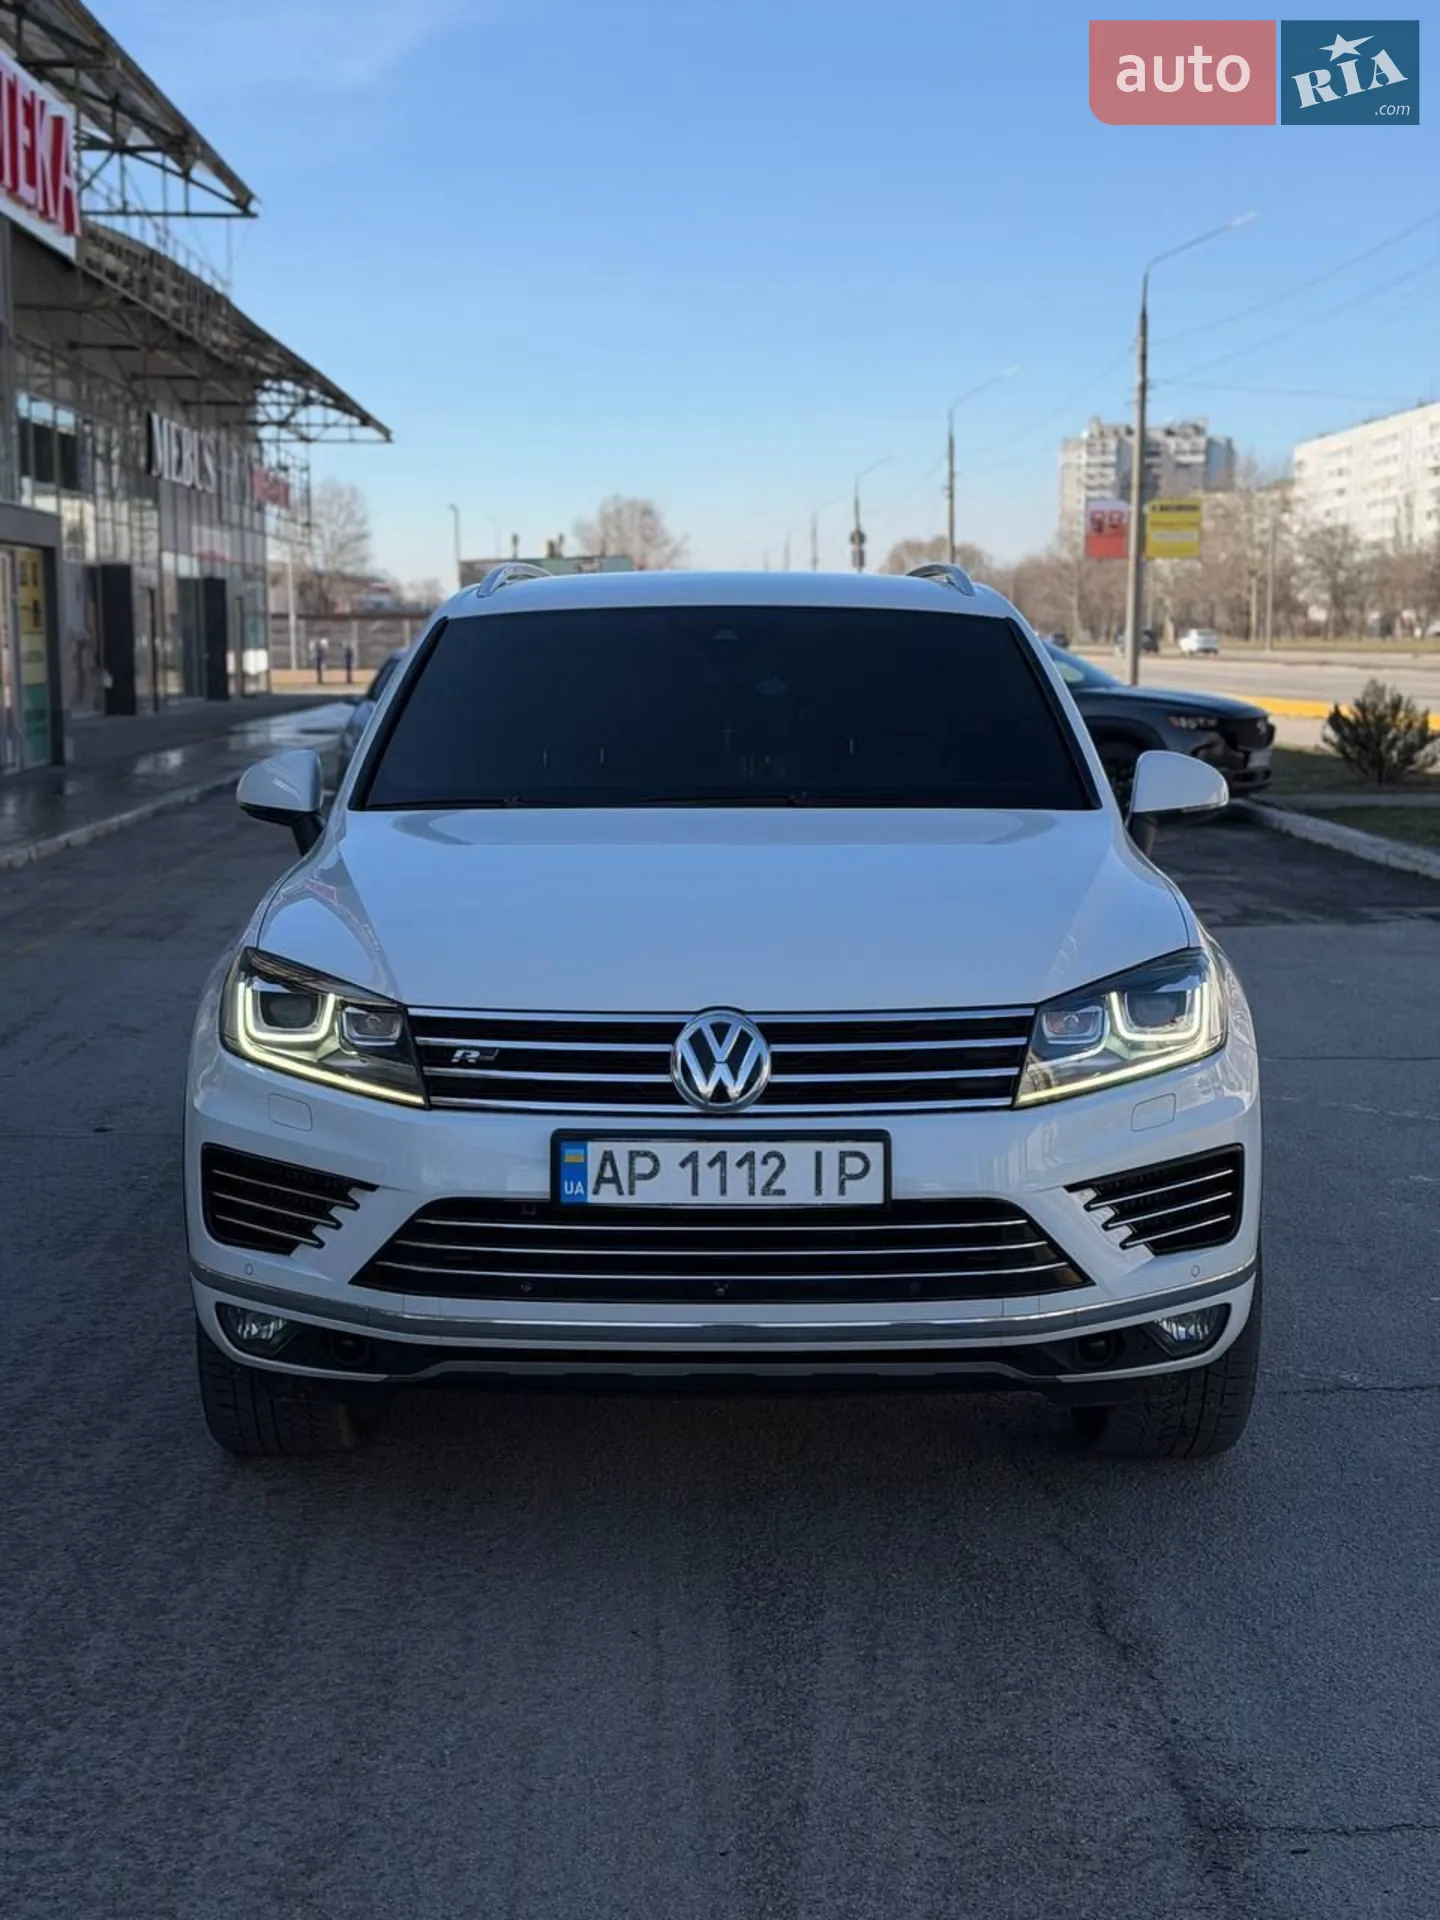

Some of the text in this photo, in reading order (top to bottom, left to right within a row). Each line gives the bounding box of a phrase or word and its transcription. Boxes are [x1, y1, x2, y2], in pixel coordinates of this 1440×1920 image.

[563, 1180, 585, 1195] UA
[591, 1149, 872, 1197] AP 1112 IP
